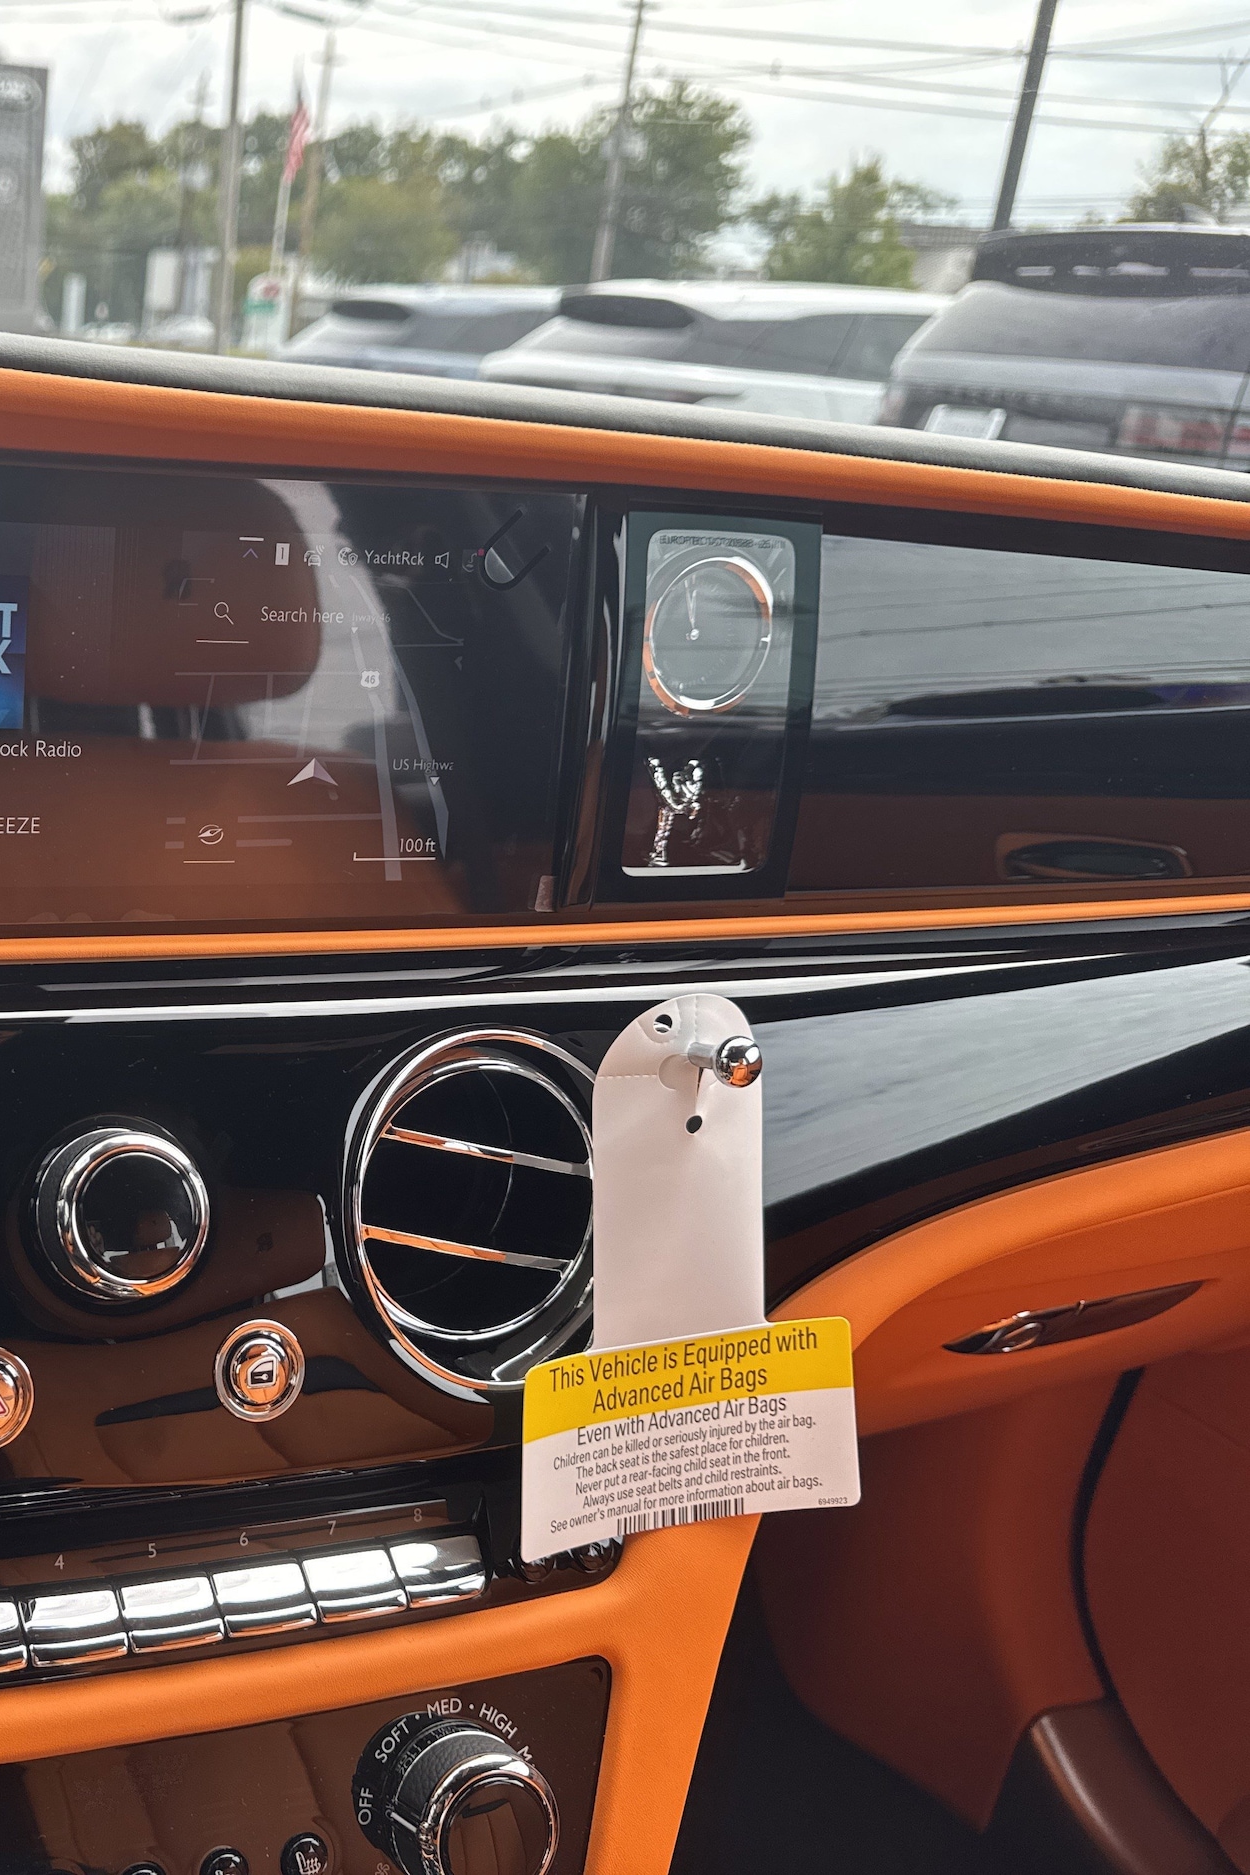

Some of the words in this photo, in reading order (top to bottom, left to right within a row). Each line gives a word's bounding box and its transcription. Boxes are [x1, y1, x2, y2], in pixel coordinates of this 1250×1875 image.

[365, 550, 424, 566] YachtRck
[261, 606, 307, 623] Search
[313, 608, 344, 623] here
[365, 674, 376, 684] 46
[35, 740, 82, 758] Radio
[392, 758, 410, 771] US
[400, 838, 424, 853] 100
[424, 838, 436, 853] ft
[549, 1363, 584, 1392] This
[589, 1351, 658, 1382] Vehicle
[663, 1347, 677, 1370] is
[684, 1331, 771, 1368] Equipped
[776, 1326, 818, 1352] with
[593, 1374, 684, 1413] Advanced
[689, 1371, 716, 1396] Air
[720, 1367, 767, 1392] Bags
[553, 1452, 590, 1471] Children
[592, 1448, 609, 1460] can
[611, 1443, 623, 1456] be
[625, 1437, 650, 1453] killed
[652, 1438, 662, 1448] or
[664, 1427, 707, 1446] seriously
[709, 1423, 742, 1440] injured
[745, 1421, 757, 1434] by
[759, 1418, 775, 1430] the
[777, 1416, 790, 1429] air
[793, 1414, 816, 1428] bag.
[577, 1424, 611, 1446] Even
[614, 1415, 644, 1437] with
[648, 1402, 720, 1431] Advanced
[723, 1399, 745, 1418] Air
[748, 1396, 787, 1417] Bags
[576, 1466, 594, 1479] The
[596, 1459, 618, 1474] back
[620, 1457, 640, 1470] seat
[642, 1453, 650, 1464] is
[652, 1449, 667, 1462] the
[670, 1445, 699, 1460] safest
[701, 1439, 727, 1456] place
[729, 1438, 743, 1450] for
[745, 1433, 789, 1447] children.
[576, 1481, 602, 1495] Never
[604, 1474, 620, 1491] put
[622, 1475, 628, 1484] a
[630, 1463, 682, 1482] rear-facing
[684, 1458, 707, 1472] child
[709, 1454, 731, 1468] seat
[732, 1452, 741, 1465] in
[744, 1450, 760, 1463] the
[762, 1447, 791, 1460] front.
[550, 1519, 567, 1533] See
[570, 1508, 605, 1527] owner's
[607, 1499, 641, 1518] manual
[644, 1497, 656, 1510] for
[659, 1494, 684, 1507] more
[687, 1484, 743, 1502] information
[746, 1480, 776, 1494] about
[777, 1477, 790, 1490] air
[793, 1476, 823, 1489] bags.
[583, 1493, 615, 1509] Always
[617, 1489, 634, 1500] use
[636, 1484, 656, 1497] seat
[659, 1478, 682, 1492] belts
[684, 1473, 703, 1488] and
[705, 1468, 728, 1484] child
[731, 1464, 782, 1480] restraints.
[54, 1554, 64, 1570] 4
[148, 1542, 157, 1558] 5
[239, 1531, 249, 1547] 6
[328, 1520, 336, 1535] 7
[413, 1508, 422, 1522] 8
[358, 1787, 374, 1825] OFF
[375, 1719, 411, 1764] SOFT
[427, 1698, 462, 1719] MED
[479, 1703, 518, 1739] HIGH
